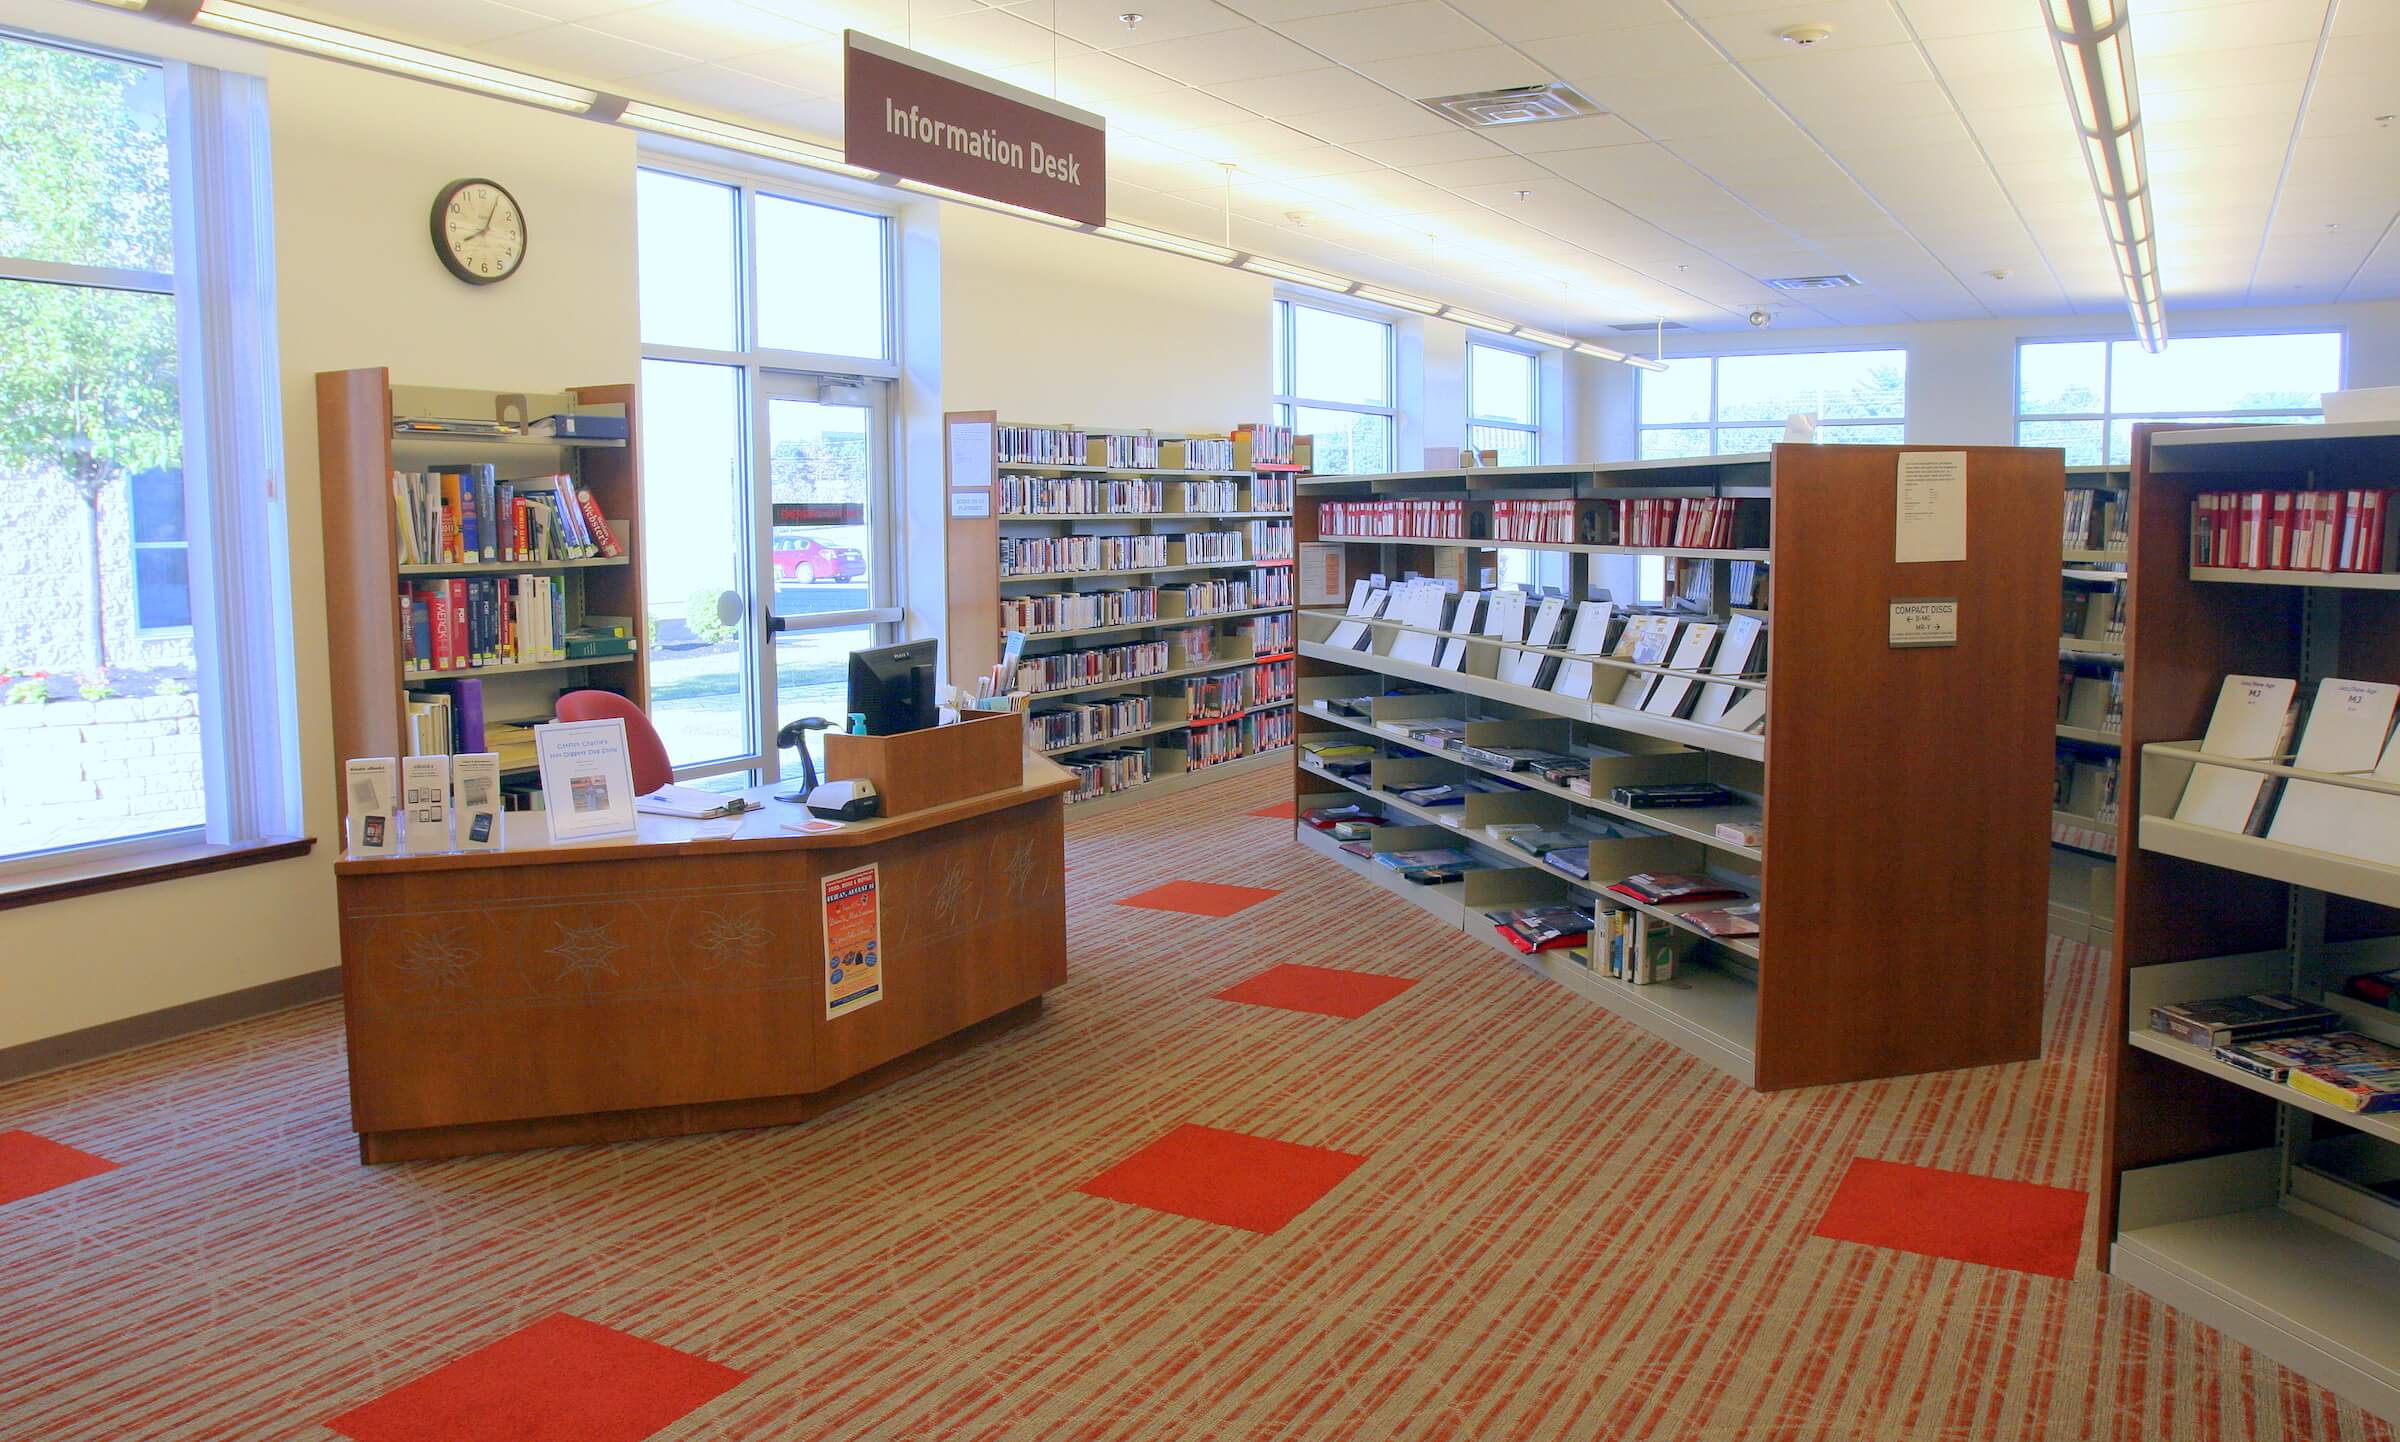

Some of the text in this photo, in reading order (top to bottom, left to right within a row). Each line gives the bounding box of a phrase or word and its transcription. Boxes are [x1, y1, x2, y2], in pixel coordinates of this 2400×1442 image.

[885, 97, 1081, 186] Information Desk
[462, 191, 471, 201] 11
[478, 189, 487, 200] 12
[450, 203, 461, 214] 10
[505, 210, 512, 222] 2
[449, 222, 457, 232] 9
[509, 230, 516, 241] 3
[454, 241, 462, 252] 8
[504, 247, 512, 257] 4
[466, 257, 473, 267] 7
[481, 262, 488, 273] 6
[496, 260, 504, 271] 5
[582, 501, 609, 546] Webster's
[1895, 605, 1953, 615] COMPACT DISCS
[436, 602, 448, 639] MERCK
